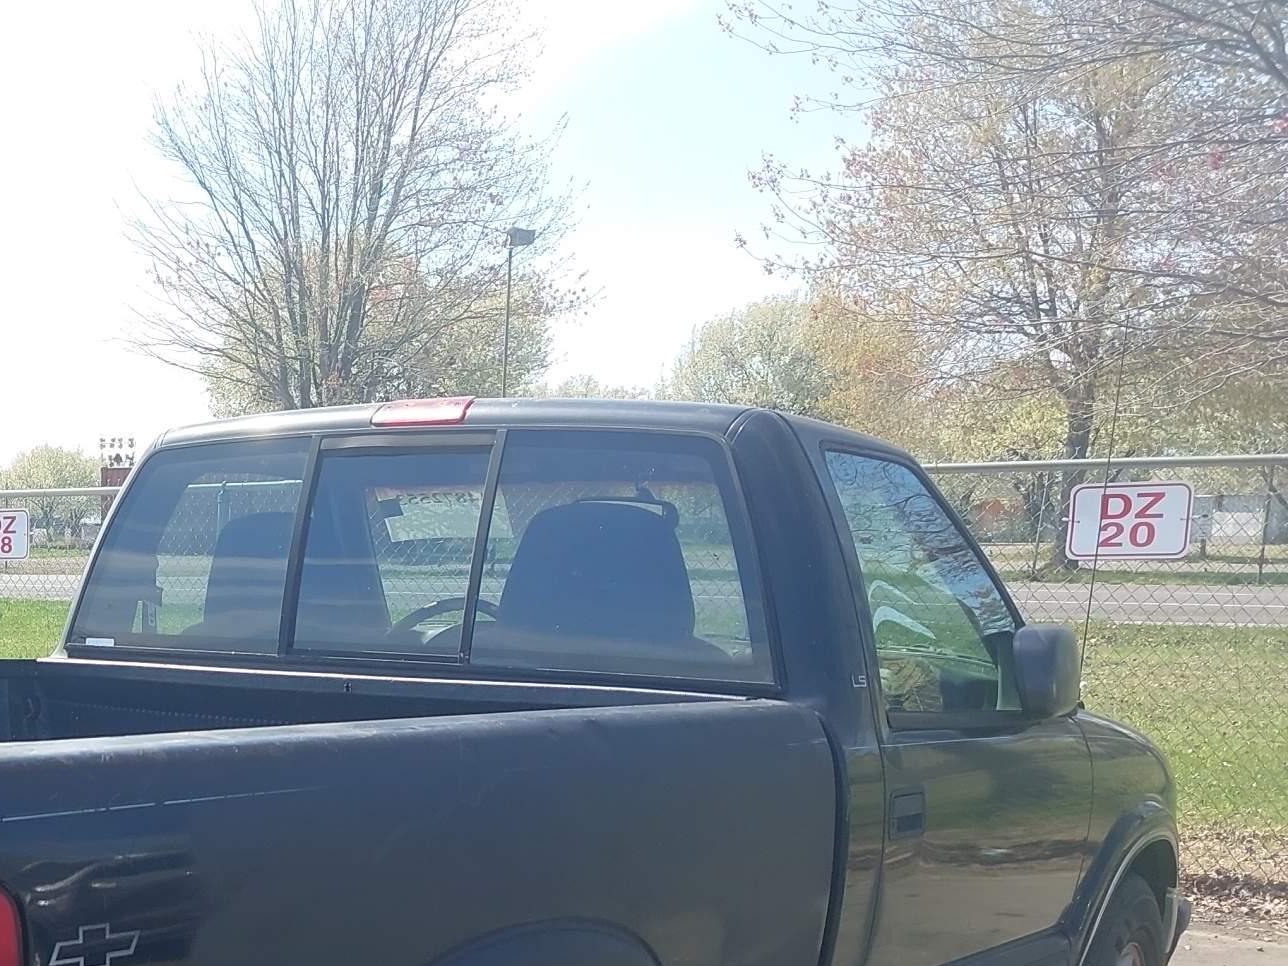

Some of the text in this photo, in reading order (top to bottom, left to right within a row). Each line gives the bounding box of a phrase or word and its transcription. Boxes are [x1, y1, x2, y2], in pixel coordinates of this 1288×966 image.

[1100, 492, 1166, 519] DZ
[1097, 522, 1156, 547] 20
[851, 674, 867, 688] LS
